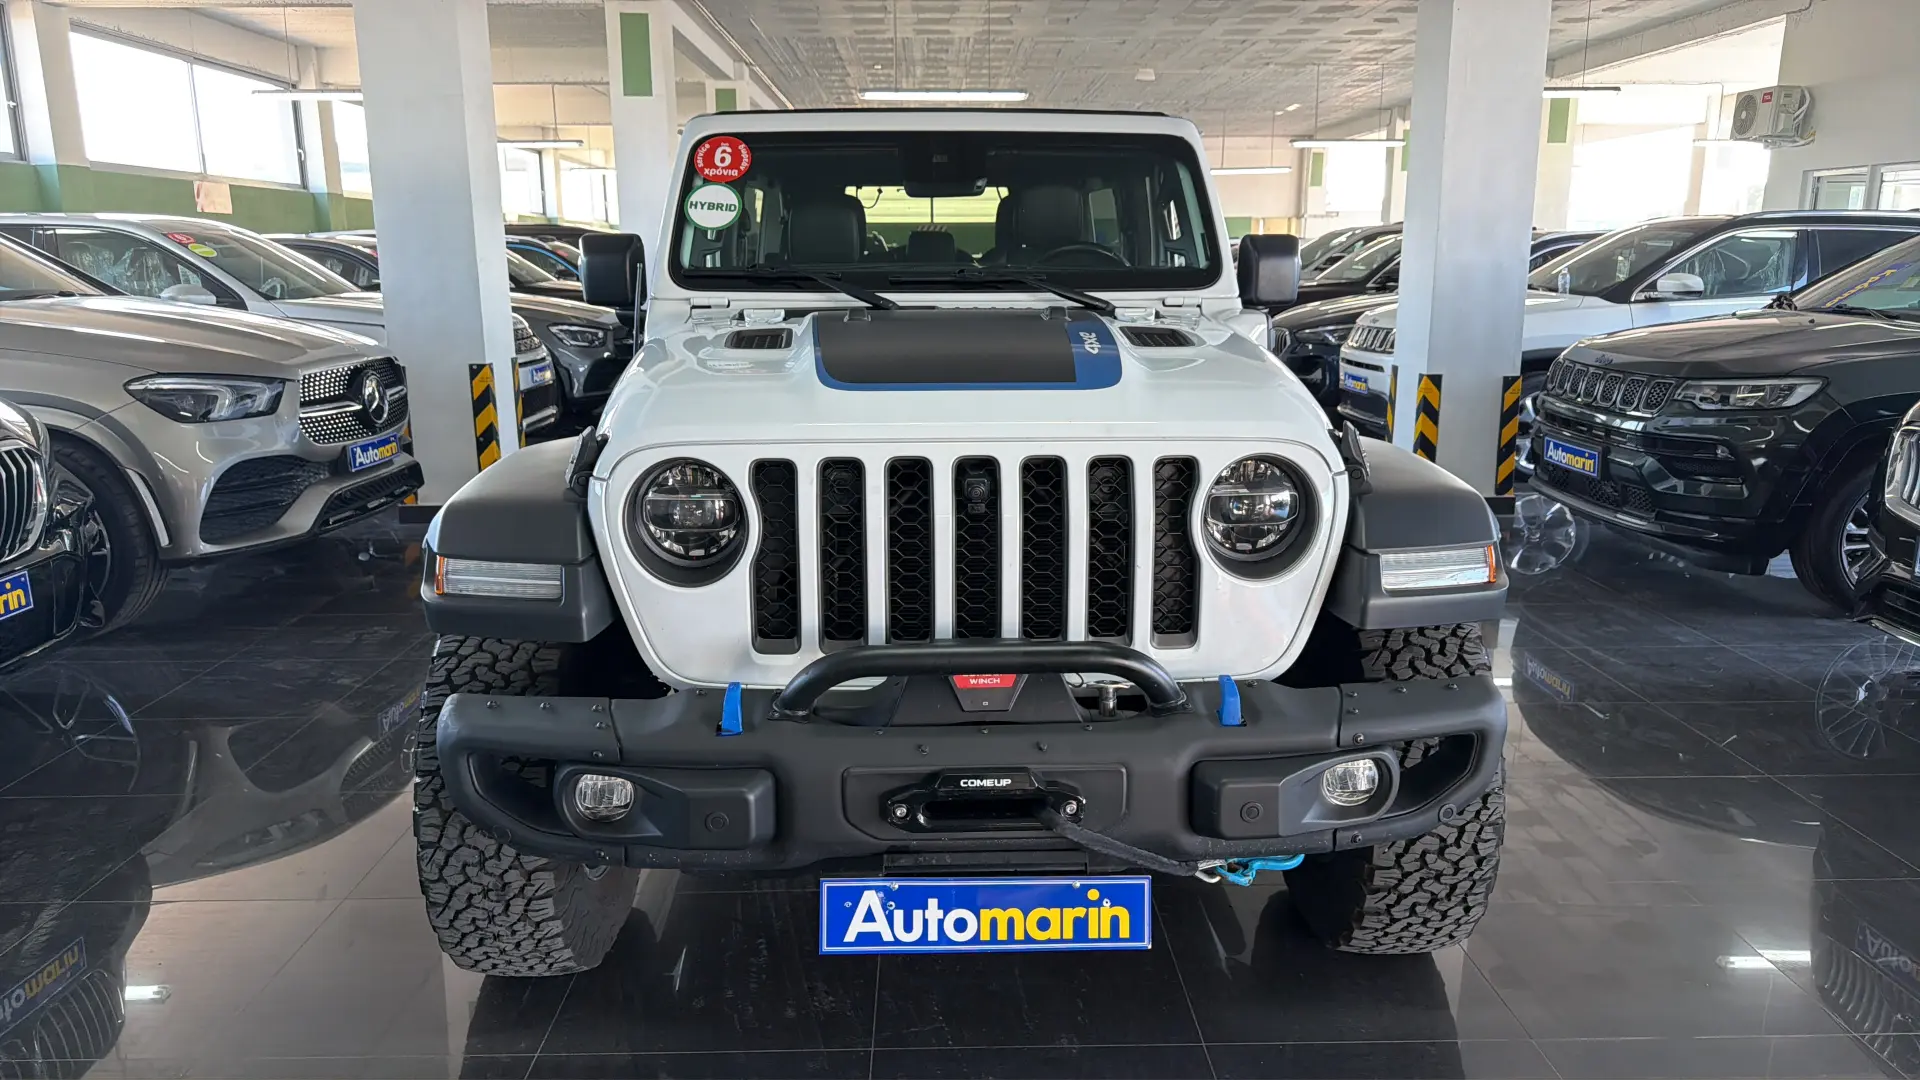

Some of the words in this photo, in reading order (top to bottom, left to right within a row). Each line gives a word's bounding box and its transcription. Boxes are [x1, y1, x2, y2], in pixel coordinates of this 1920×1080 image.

[697, 143, 711, 168] service
[714, 146, 733, 168] 6
[703, 167, 738, 177] χρόνια
[688, 200, 737, 212] HYBRID
[1079, 331, 1101, 355] 4xe
[1547, 441, 1595, 473] Automarin
[969, 677, 1001, 685] WINCH
[960, 778, 1012, 787] COMEUP
[843, 890, 1130, 943] Automarin
